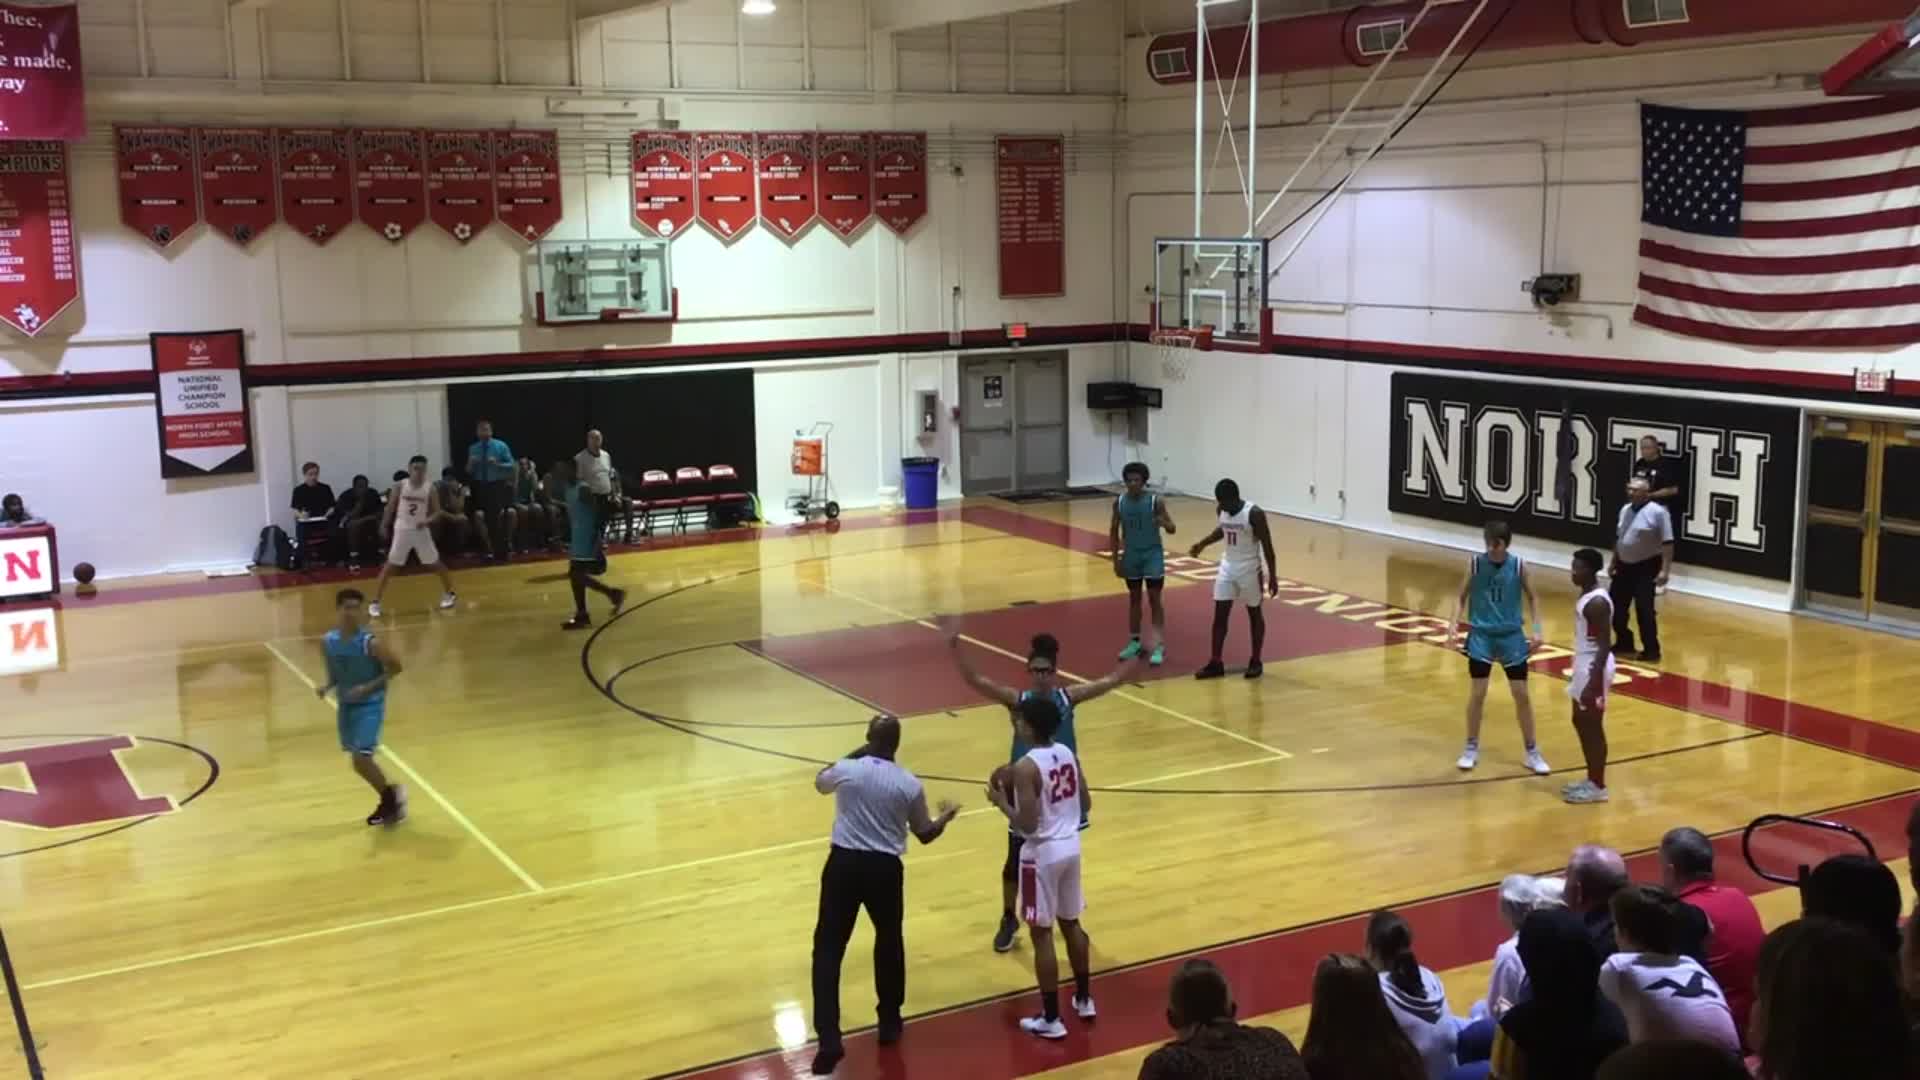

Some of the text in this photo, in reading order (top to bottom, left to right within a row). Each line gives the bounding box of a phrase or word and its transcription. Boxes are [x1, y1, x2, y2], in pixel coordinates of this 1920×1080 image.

[0, 9, 42, 28] hee,
[14, 53, 71, 71] made,
[177, 375, 222, 384] NATIONAL
[183, 384, 218, 392] UNIFIED
[177, 392, 226, 401] CHAMPION
[184, 401, 220, 409] SCHOOL
[1402, 397, 1771, 552] NORTH
[4, 550, 41, 581] N
[1049, 763, 1077, 804] 23
